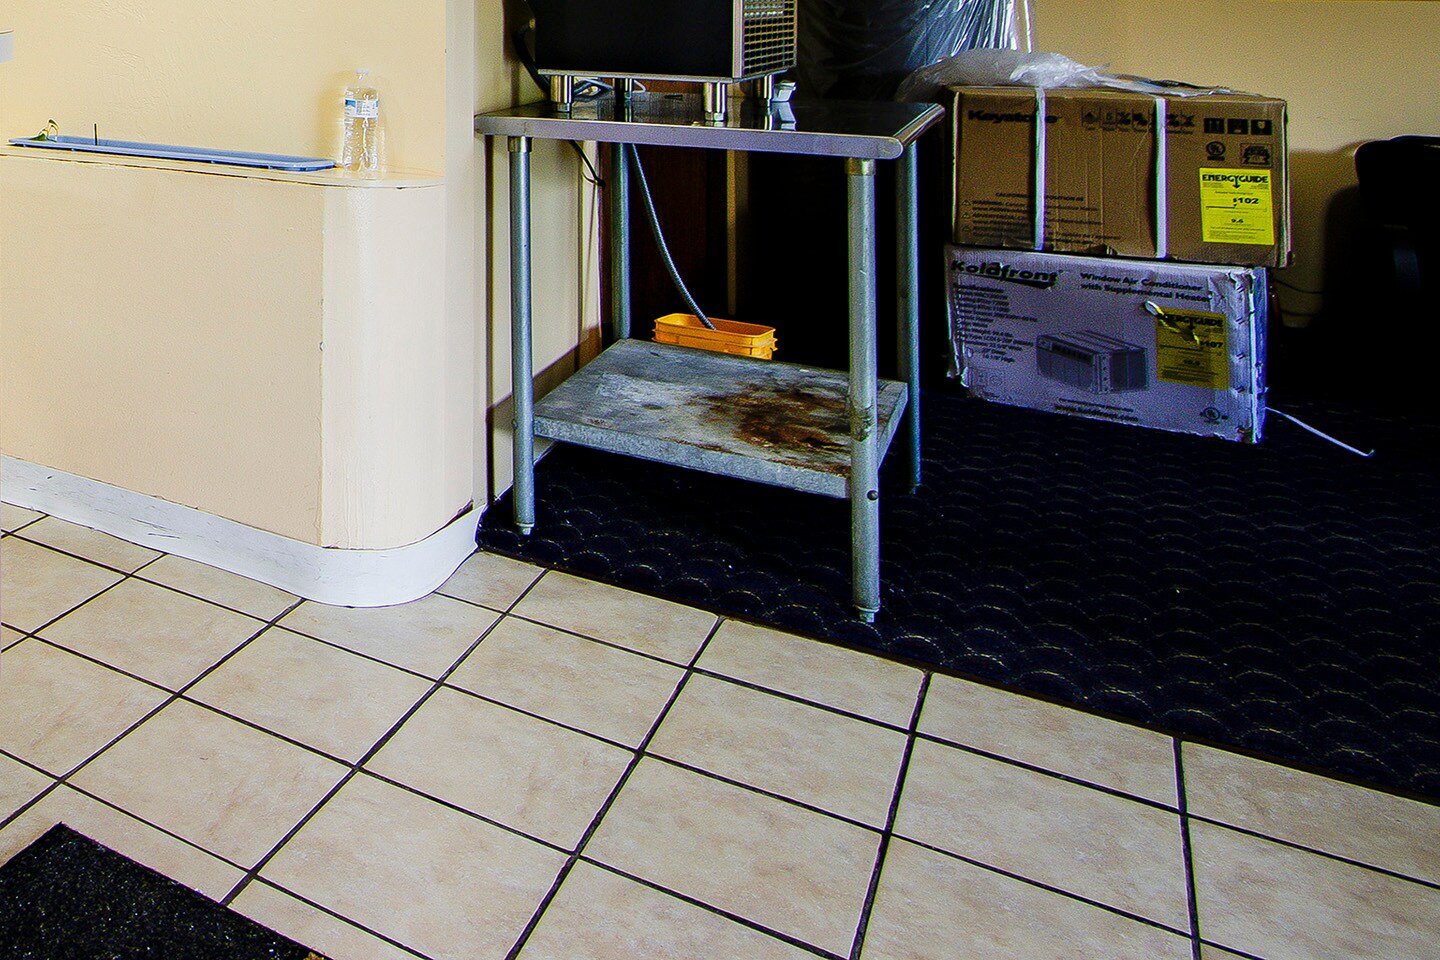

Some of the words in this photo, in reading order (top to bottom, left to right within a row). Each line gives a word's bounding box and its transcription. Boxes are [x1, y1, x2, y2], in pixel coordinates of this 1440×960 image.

[951, 260, 1058, 281] Koldfront
[1080, 272, 1120, 284] Window
[1122, 277, 1138, 287] Air
[1141, 279, 1203, 292] Conditioner
[1080, 283, 1102, 291] with
[1104, 285, 1173, 299] Supplemental
